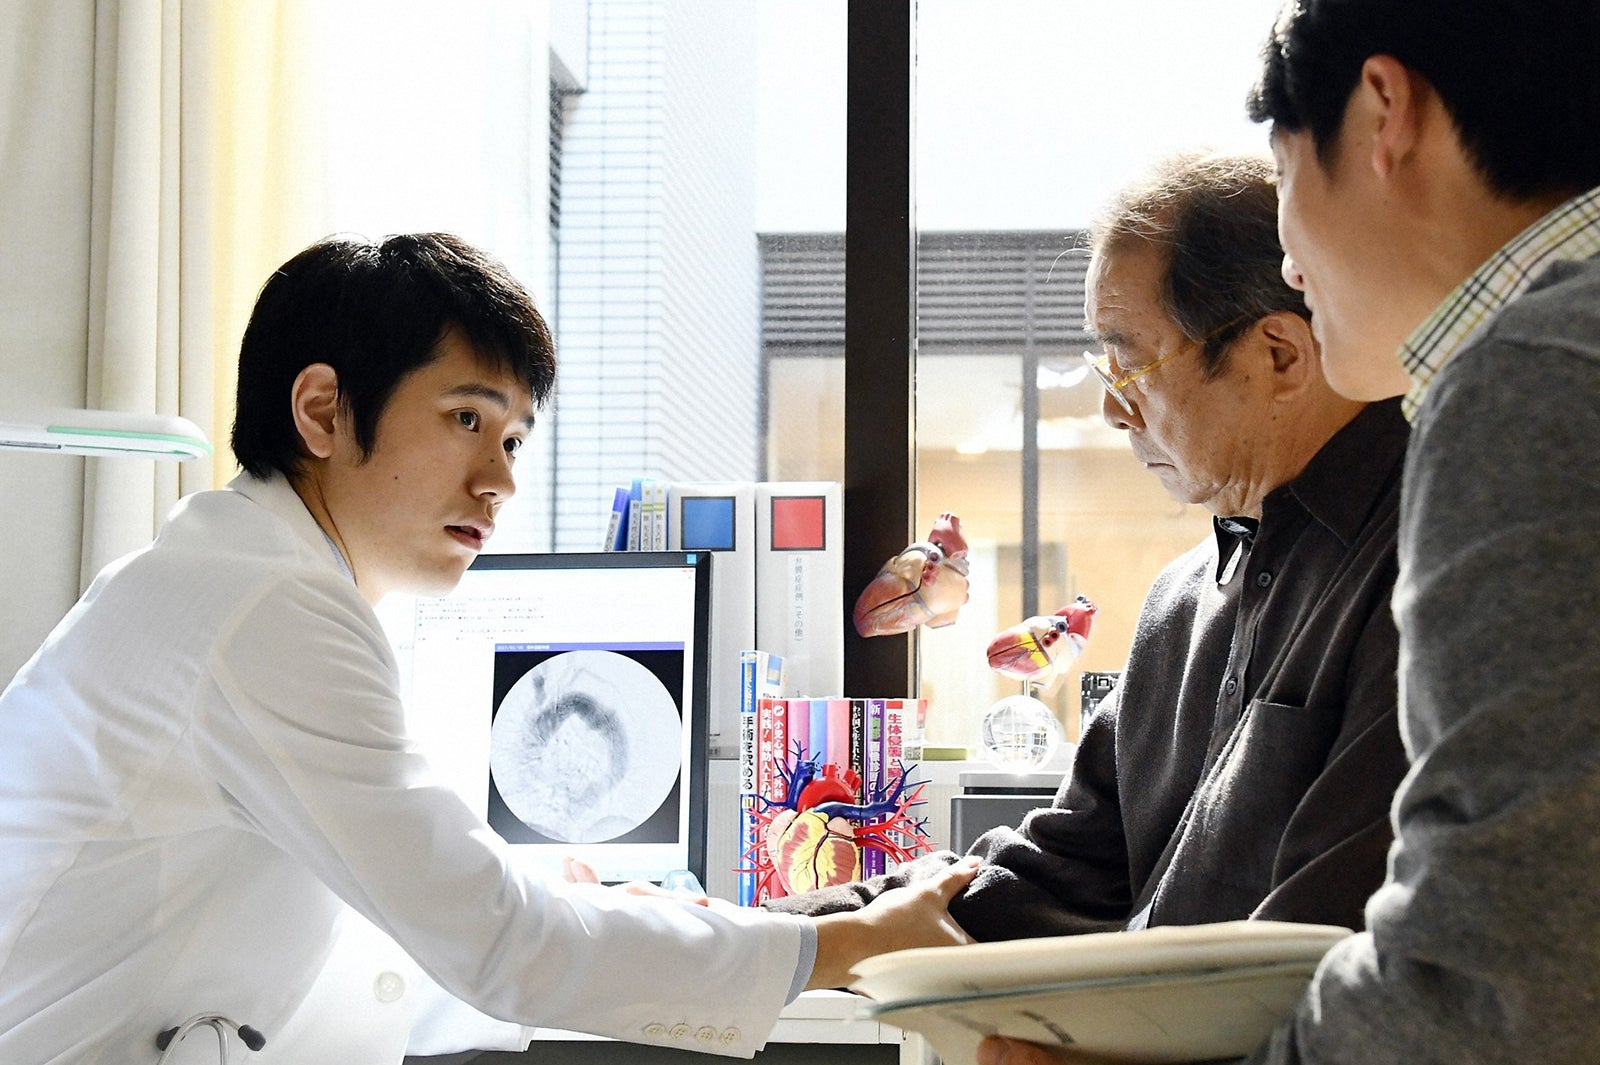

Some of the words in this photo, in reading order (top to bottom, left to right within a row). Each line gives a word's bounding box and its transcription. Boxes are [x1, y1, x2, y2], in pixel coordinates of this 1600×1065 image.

[742, 716, 753, 790] 手術を究める
